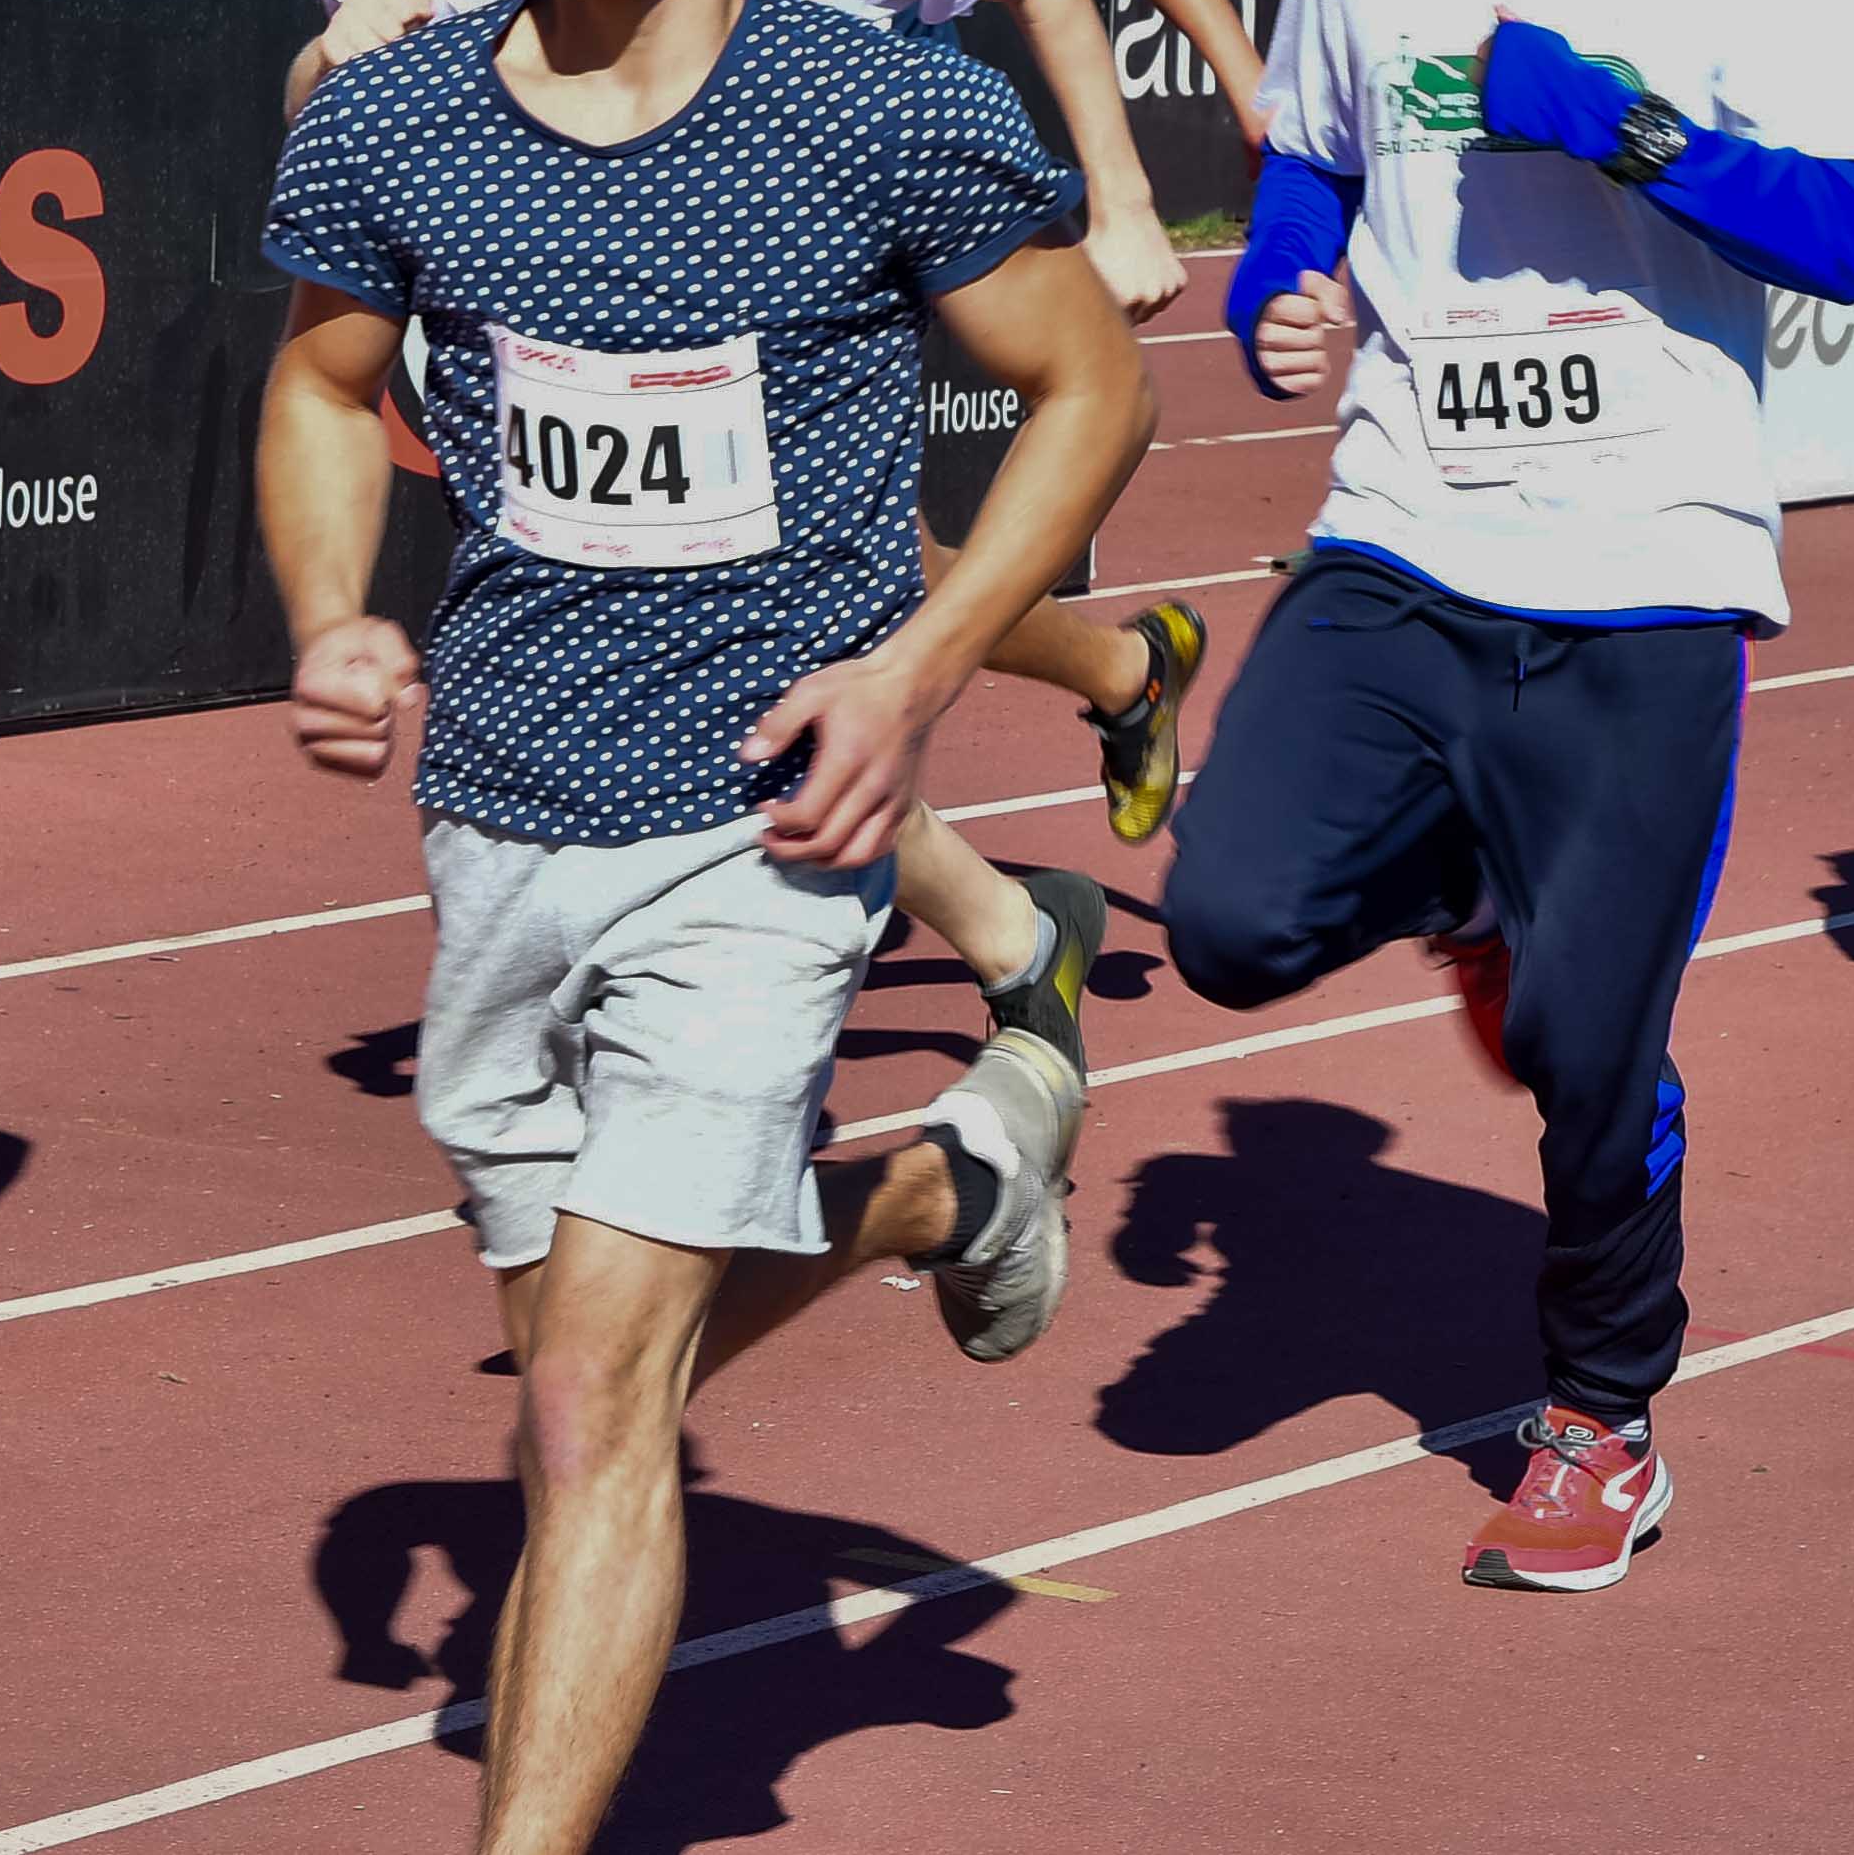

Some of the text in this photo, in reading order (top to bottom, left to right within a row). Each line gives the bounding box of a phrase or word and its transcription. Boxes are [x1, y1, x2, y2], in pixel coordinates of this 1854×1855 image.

[927, 380, 1021, 437] House
[1437, 352, 1602, 432] 4439
[506, 402, 691, 506] 4024
